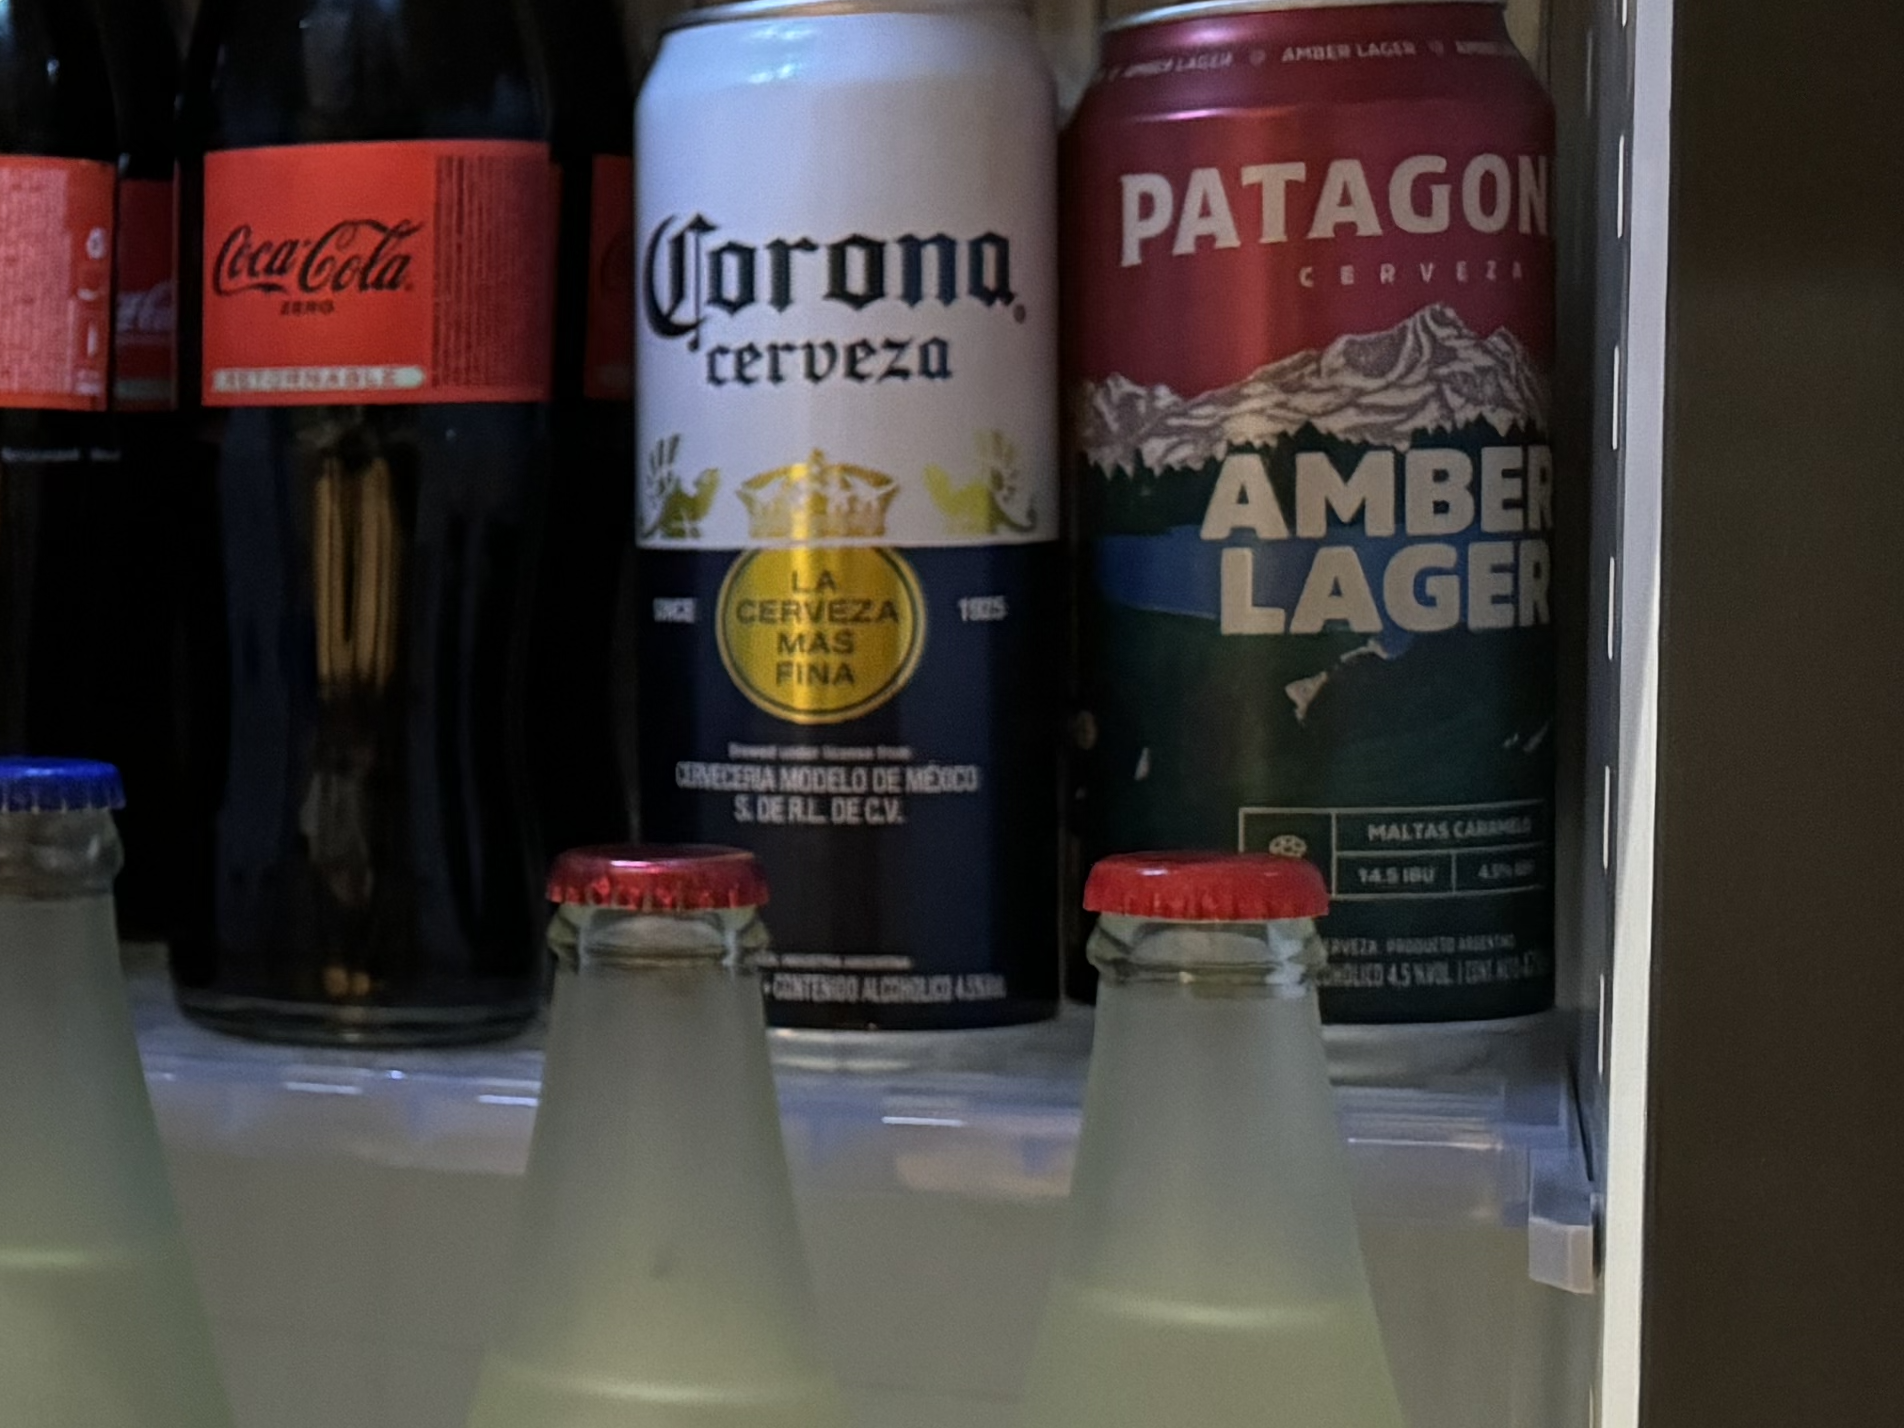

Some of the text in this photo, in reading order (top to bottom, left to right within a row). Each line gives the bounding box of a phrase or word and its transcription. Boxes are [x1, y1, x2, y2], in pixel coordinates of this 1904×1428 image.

[1281, 39, 1417, 63] AMBER LAGER
[213, 218, 426, 298] Coca-Cola
[643, 211, 1016, 353] Corona
[1300, 258, 1524, 288] CERVEZA
[705, 334, 954, 388] cerveza
[1200, 445, 1553, 542] AMBER
[792, 570, 838, 594] LA
[1219, 538, 1552, 636] LAGER
[736, 597, 899, 624] CERVEZA
[776, 629, 855, 655] MAS
[775, 661, 856, 686] FINA
[780, 765, 868, 794] MODELO
[872, 766, 902, 794] DE
[906, 759, 979, 794] MÉXICO
[756, 795, 785, 823] DE
[831, 795, 862, 824] DE
[1367, 820, 1450, 842] MALTAS
